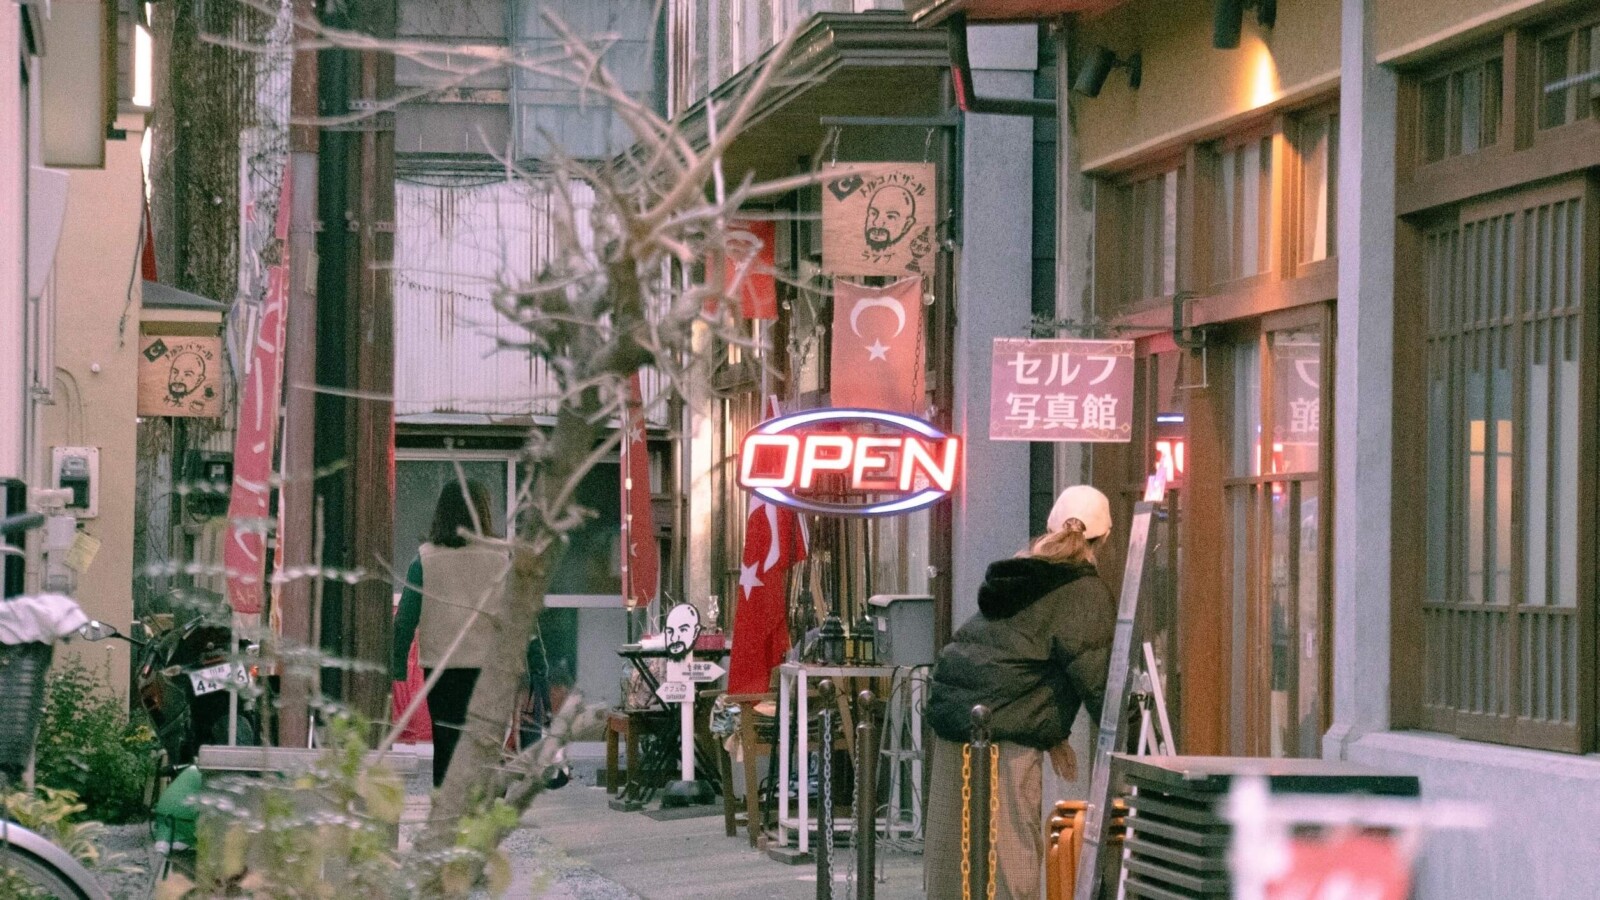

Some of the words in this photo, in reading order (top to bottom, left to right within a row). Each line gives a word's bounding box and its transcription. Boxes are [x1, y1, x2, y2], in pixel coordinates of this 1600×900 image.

[860, 171, 926, 198] トルコバザール
[1007, 352, 1117, 386] セルフ
[1005, 392, 1118, 430] 写真館
[740, 434, 959, 491] OPEN
